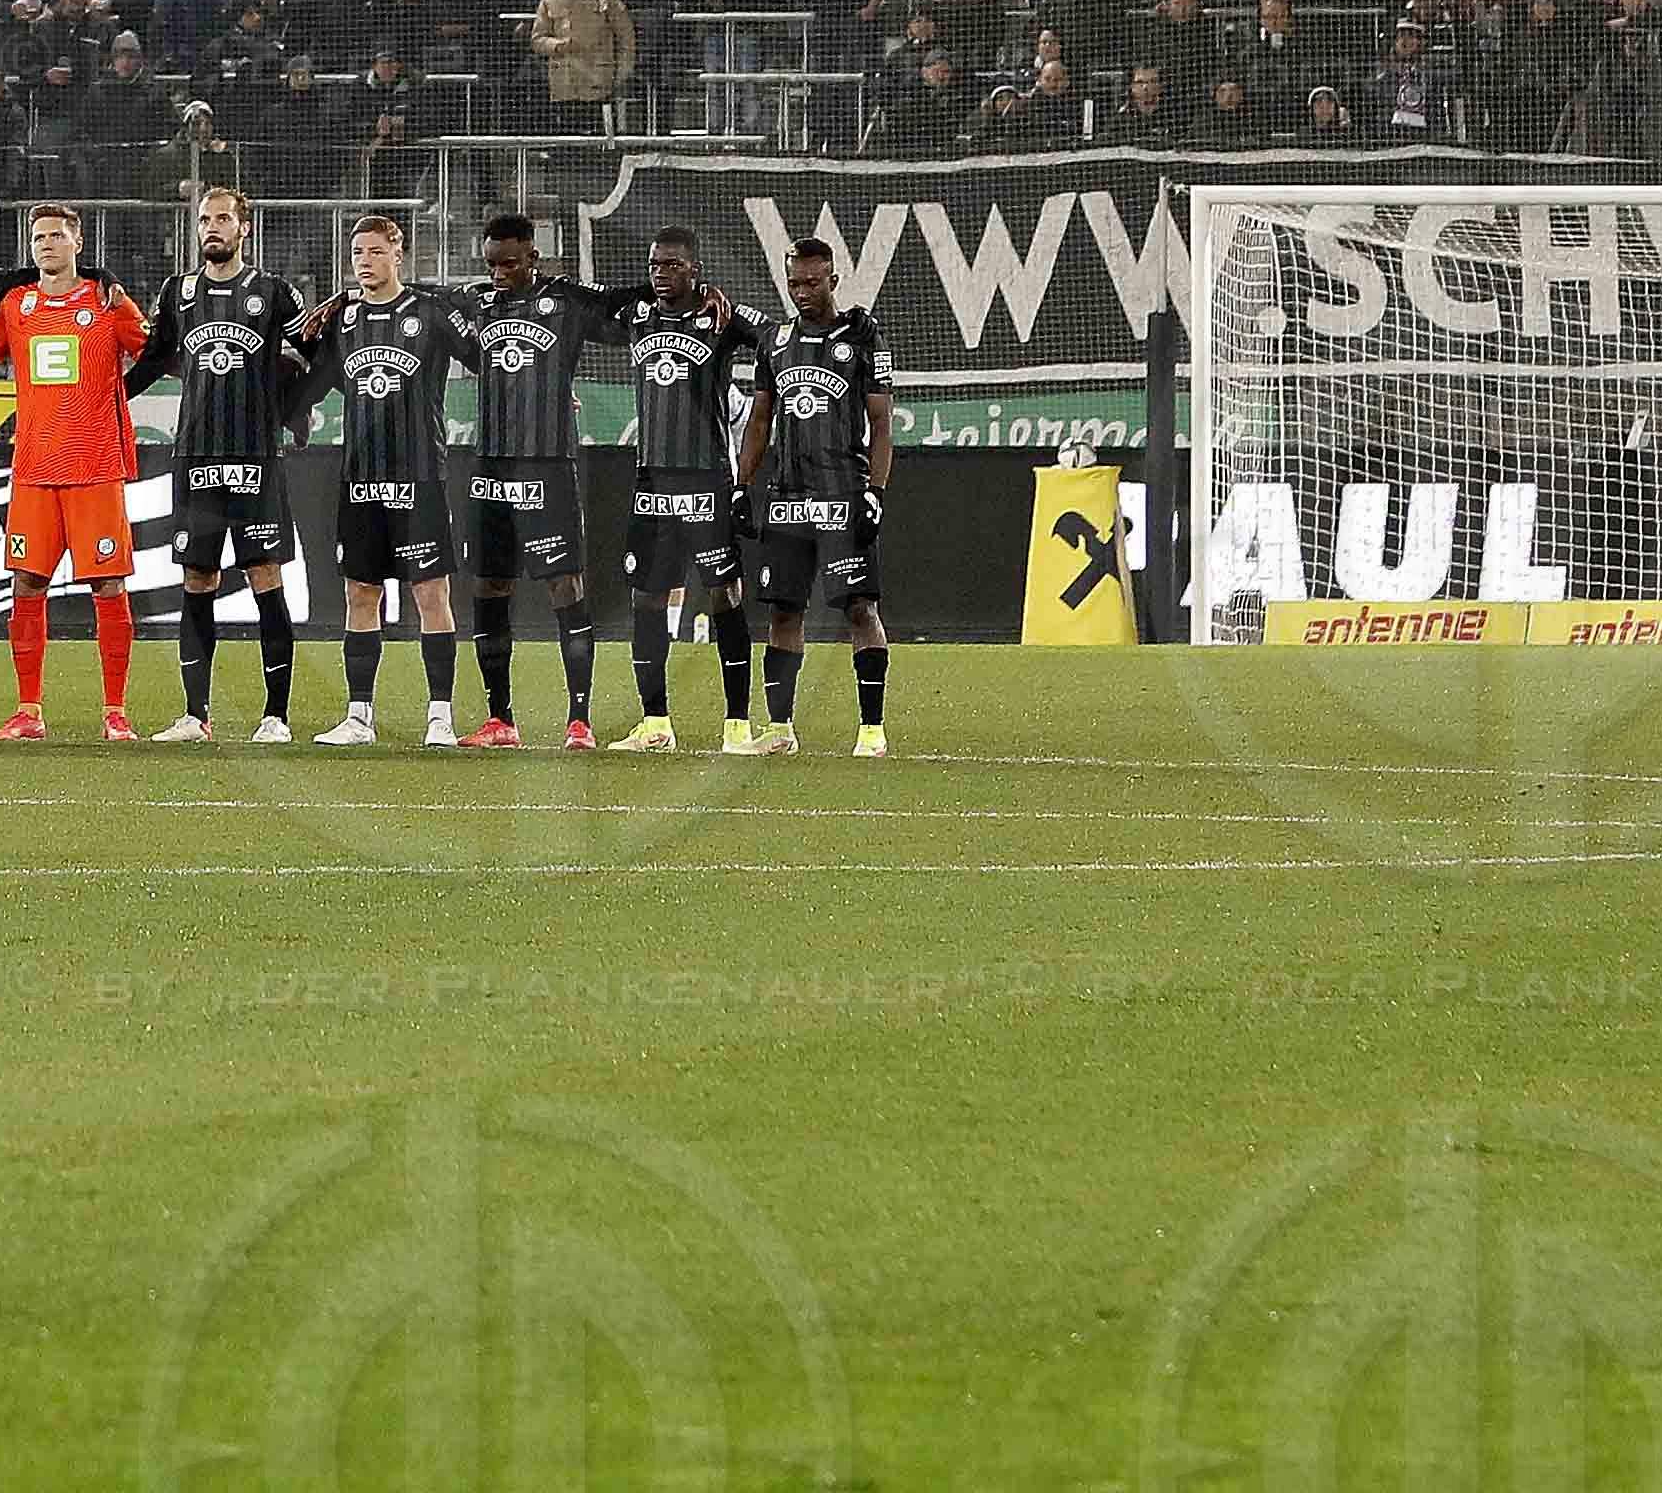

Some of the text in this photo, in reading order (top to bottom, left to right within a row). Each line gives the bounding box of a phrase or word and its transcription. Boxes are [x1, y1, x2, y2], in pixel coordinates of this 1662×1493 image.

[187, 325, 261, 350] PUNTIGAMER
[482, 321, 554, 348] PUNTIGAMER
[635, 334, 710, 362] PUNTIGAMER
[347, 349, 417, 374] PUNTIGAMER
[777, 368, 845, 396] PUNTIGAMER
[190, 465, 261, 489] GRAZ
[469, 477, 544, 502] GRAZ
[350, 482, 415, 503] GRAZ
[634, 493, 714, 516] GRAZ
[768, 501, 849, 524] GRAZ
[1112, 480, 1572, 604] AUL
[1302, 605, 1488, 644] antenne
